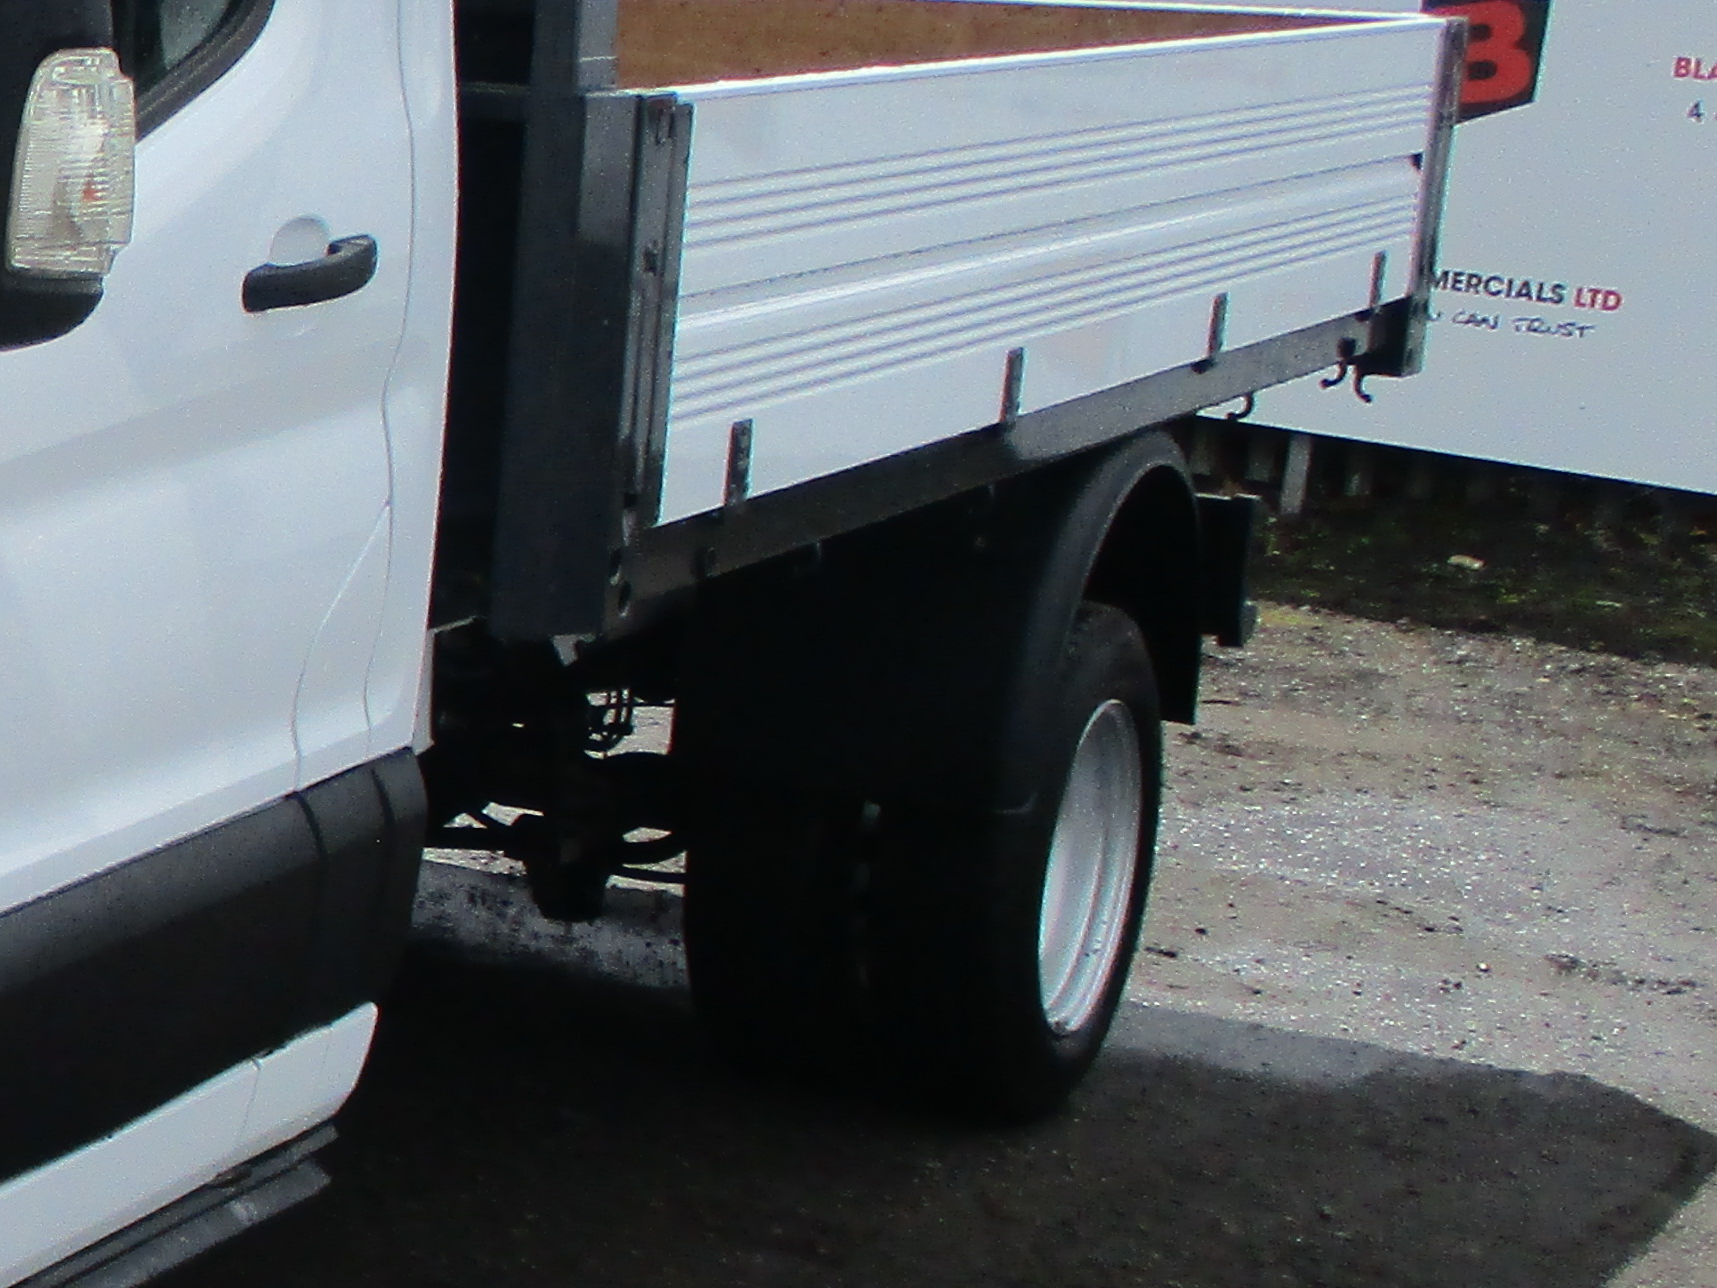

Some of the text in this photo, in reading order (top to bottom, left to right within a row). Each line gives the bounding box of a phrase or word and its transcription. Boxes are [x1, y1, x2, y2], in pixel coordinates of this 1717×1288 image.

[1574, 287, 1623, 311] LTD
[1452, 311, 1499, 330] CAN
[1513, 316, 1595, 339] TRUST
